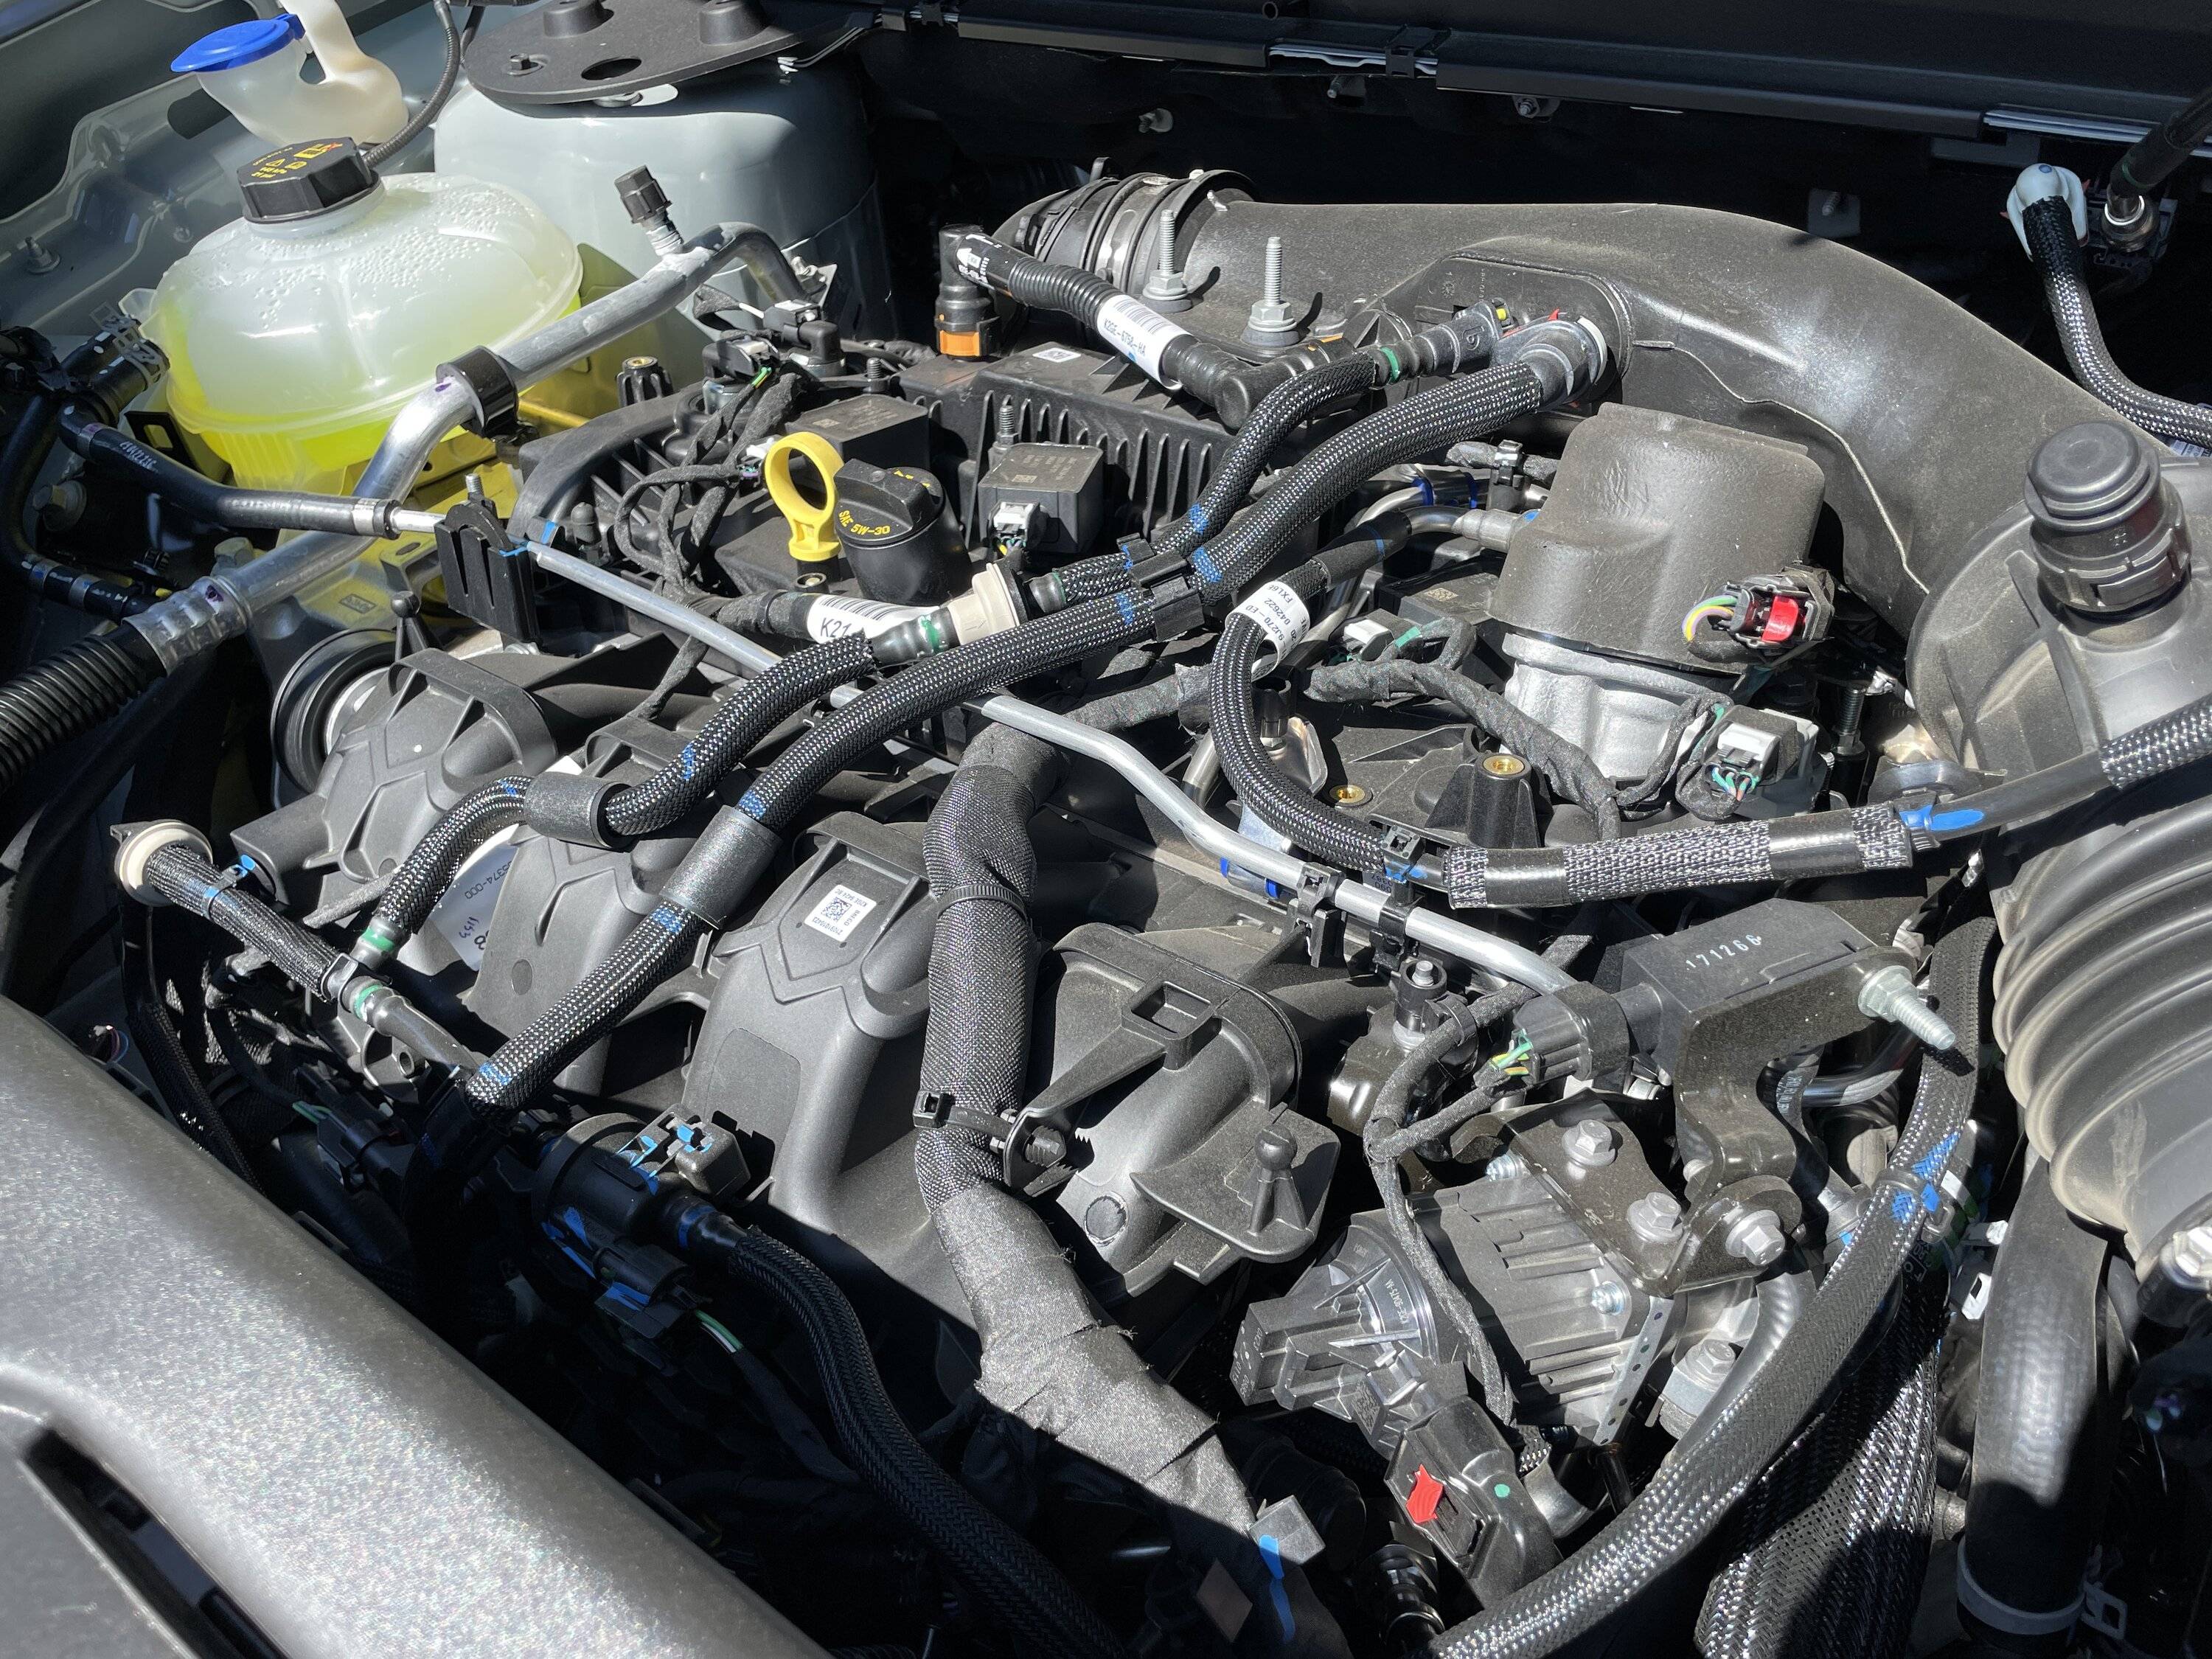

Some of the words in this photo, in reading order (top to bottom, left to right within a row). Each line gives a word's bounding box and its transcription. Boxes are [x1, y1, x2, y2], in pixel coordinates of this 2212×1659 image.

[838, 509, 854, 527] SAE
[850, 524, 891, 535] 5W-30
[1264, 597, 1291, 625] 042622
[1686, 934, 1761, 968] 171266
